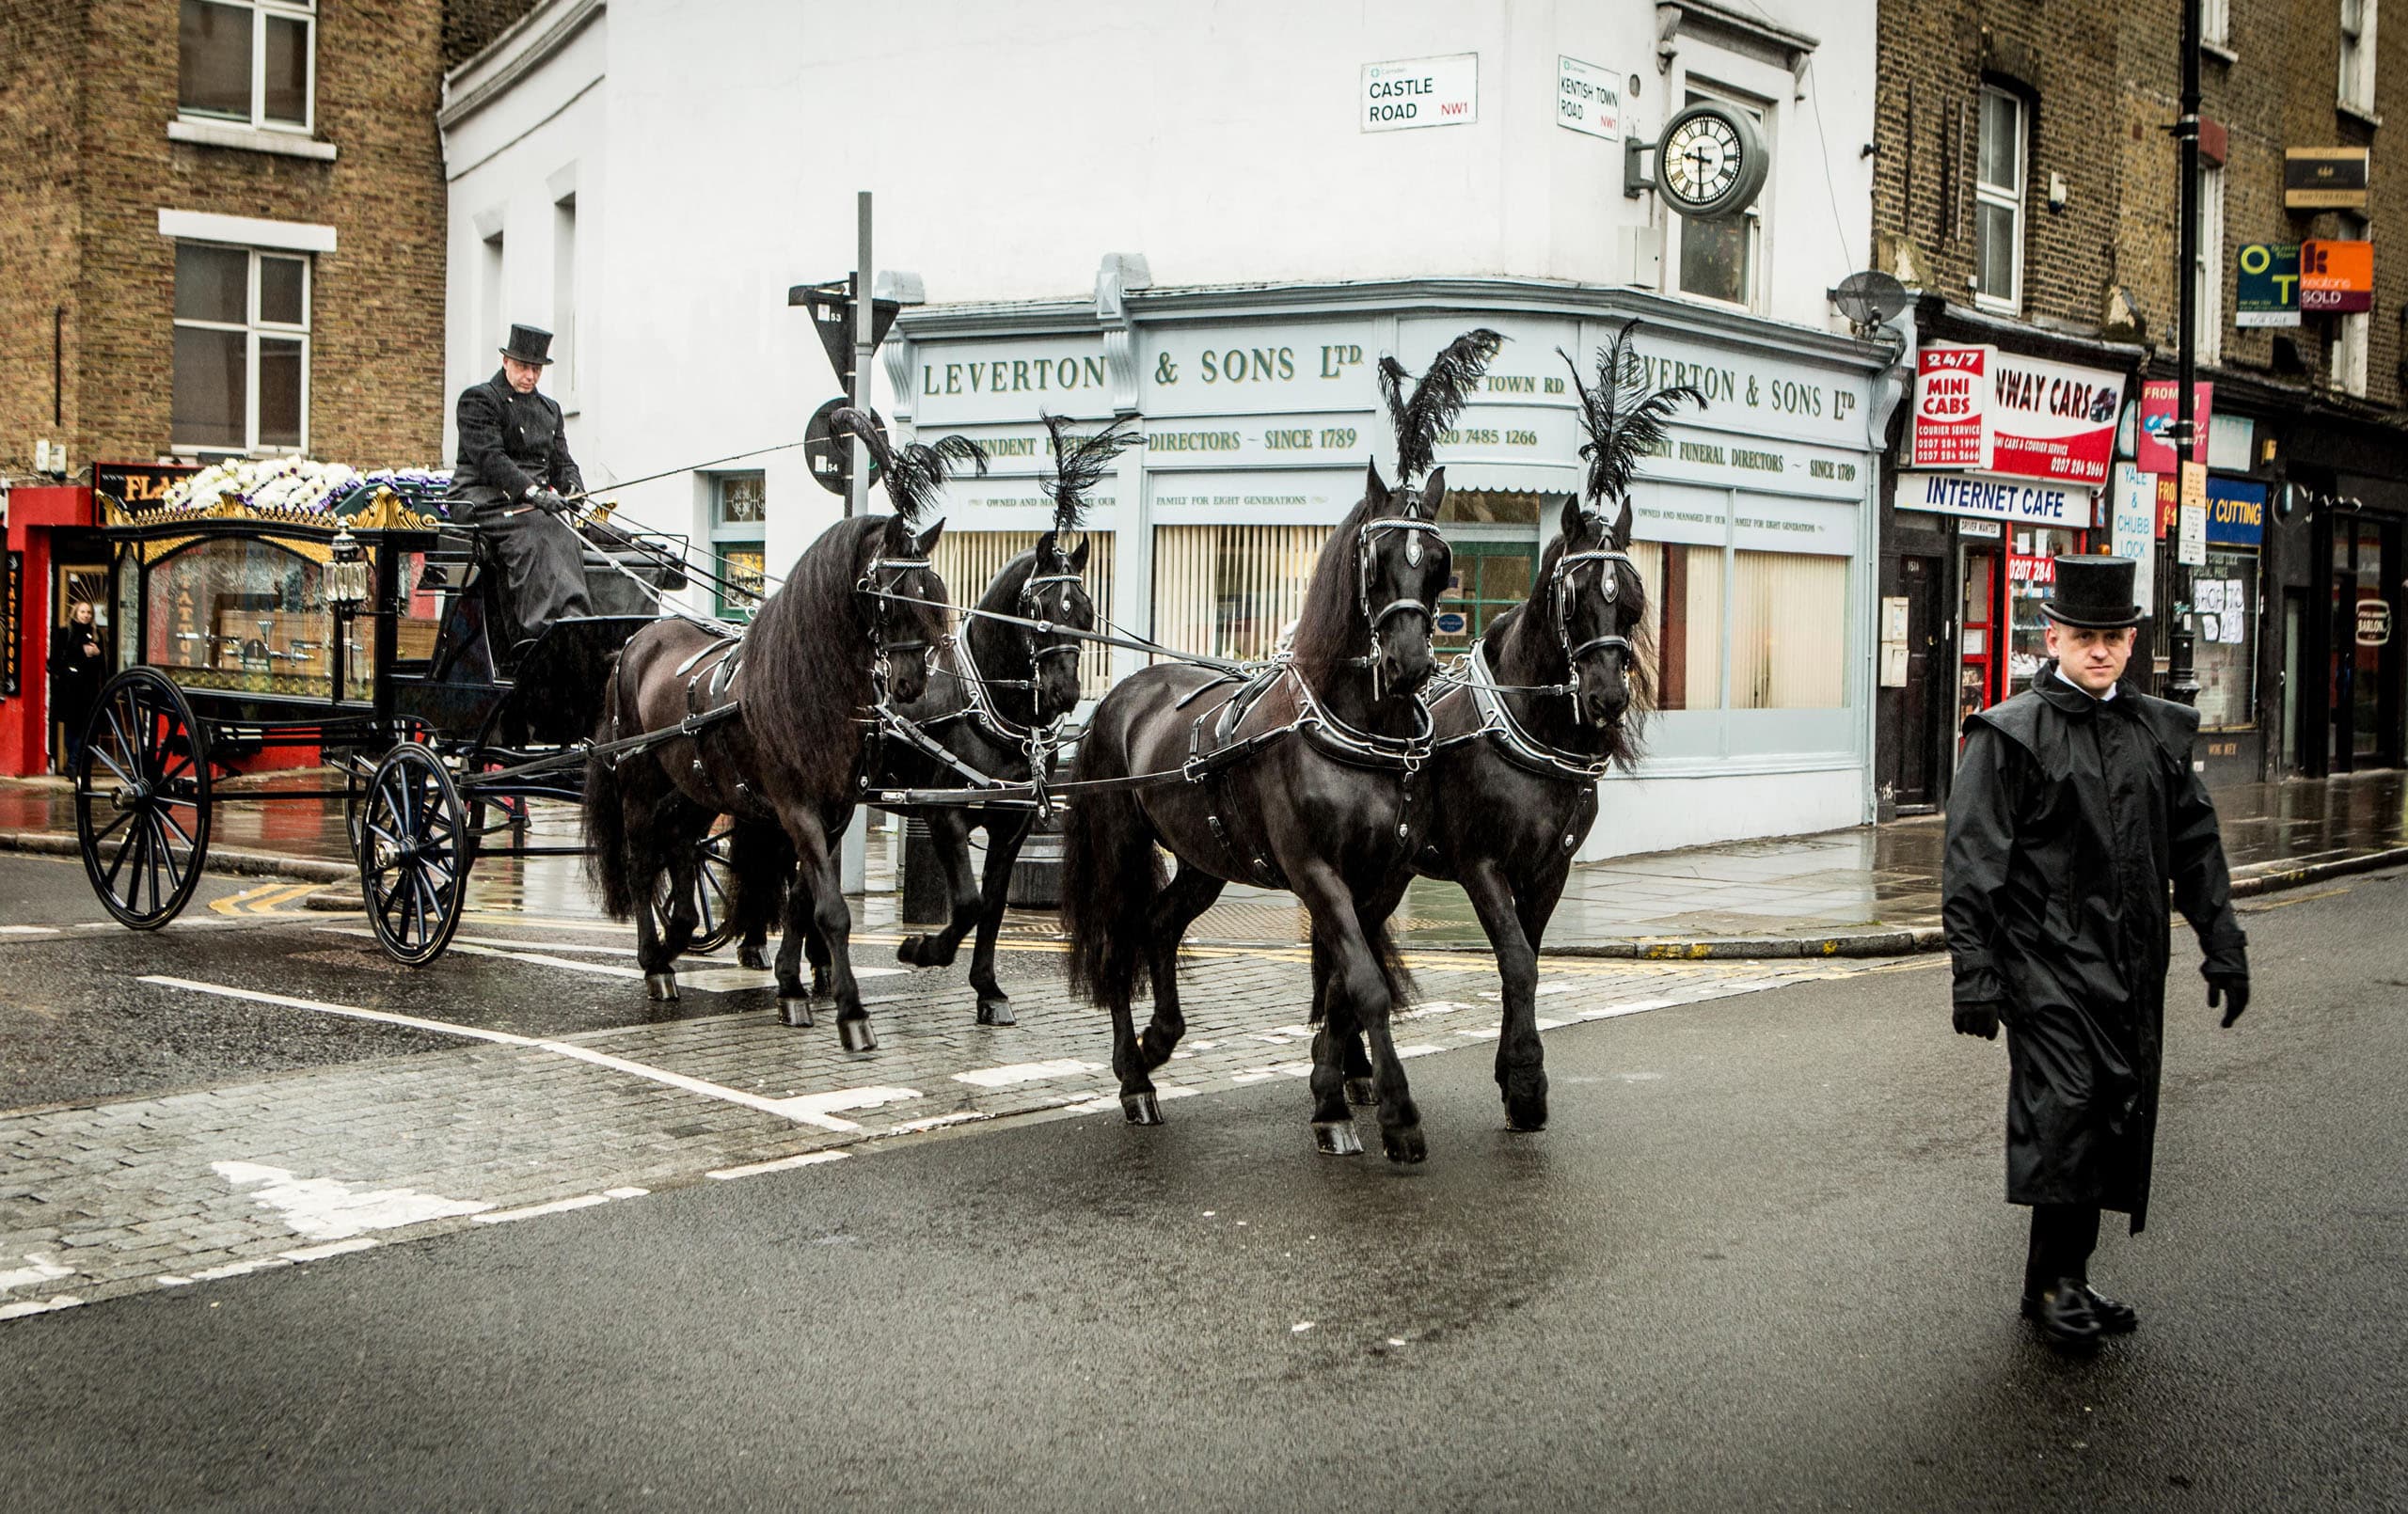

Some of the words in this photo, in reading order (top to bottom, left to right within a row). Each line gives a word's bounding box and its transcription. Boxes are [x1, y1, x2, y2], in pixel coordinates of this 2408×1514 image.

[1370, 78, 1434, 99] CASTLE
[1561, 76, 1593, 100] KENTISH
[1596, 87, 1618, 108] TOWN
[1370, 103, 1418, 121] ROAD
[1441, 103, 1467, 116] NW1
[1561, 99, 1583, 119] ROAD
[1601, 115, 1616, 131] NW1
[2302, 290, 2341, 304] SOLD
[831, 312, 842, 323] 53
[1927, 353, 1978, 368] 24/7
[924, 355, 1106, 396] LEVERTON
[1155, 351, 1179, 386] &
[1201, 346, 1295, 384] SONS
[1486, 376, 1535, 393] TOWN
[1927, 378, 1970, 395] MINI
[2145, 386, 2178, 400] FROM
[1746, 373, 1759, 408] &
[1772, 379, 1821, 418] SONS
[2050, 378, 2092, 420] CARS
[1924, 398, 1970, 415] CABS
[1465, 429, 1499, 444] 7485
[1506, 430, 1537, 445] 1266
[1918, 425, 1950, 435] COURIER
[1952, 425, 1980, 435] SERVICE
[1148, 431, 1241, 451] DIRECTORS
[1265, 429, 1312, 449] SINCE
[1321, 428, 1357, 449] 1789
[1918, 438, 1938, 449] 0207
[1941, 438, 1956, 449] 284
[1959, 438, 1980, 449] 1999
[2004, 438, 2019, 449] CABS
[2025, 440, 2048, 453] COURIER
[2048, 443, 2068, 456] SERVICE
[1680, 441, 1725, 465] FUNERAL
[1731, 450, 1783, 473] DIRECTORS
[1810, 459, 1834, 480] SINCE
[1837, 461, 1856, 481] 1789
[1918, 450, 1938, 460] 0207
[1941, 450, 1956, 460] 284
[1959, 450, 1980, 460] 2666
[827, 463, 838, 473] 54
[2051, 456, 2070, 473] 0207
[2071, 459, 2085, 475] 284
[2086, 461, 2104, 478] 2666
[2125, 465, 2147, 485] YALE
[987, 498, 1016, 507] OWNED
[1021, 498, 1037, 507] AND
[1099, 497, 1116, 506] OUR
[1157, 496, 1188, 505] FAMILY
[1192, 496, 1210, 505] FOR
[1213, 496, 1240, 505] EIGHT
[1244, 495, 1307, 505] GENERATIONS
[1926, 476, 2019, 512] INTERNET
[2022, 488, 2065, 517] CAFE
[2131, 492, 2137, 509] &
[2158, 481, 2178, 503] FRO
[1639, 507, 1661, 518] OWNED
[1663, 511, 1675, 520] AND
[1676, 512, 1703, 523] MANAGED
[1705, 514, 1712, 523] BY
[1715, 515, 1725, 524] OUR
[1753, 519, 1764, 528] FOR
[1766, 520, 1781, 529] EIGHT
[1782, 521, 1815, 532] GENERATIONS
[2215, 498, 2262, 526] CUTTING
[2117, 514, 2150, 534] CHUBB
[2120, 541, 2146, 558] LOCK
[2009, 559, 2032, 580] 0207
[2033, 560, 2052, 582] 284
[8, 571, 17, 674] TATTOOS
